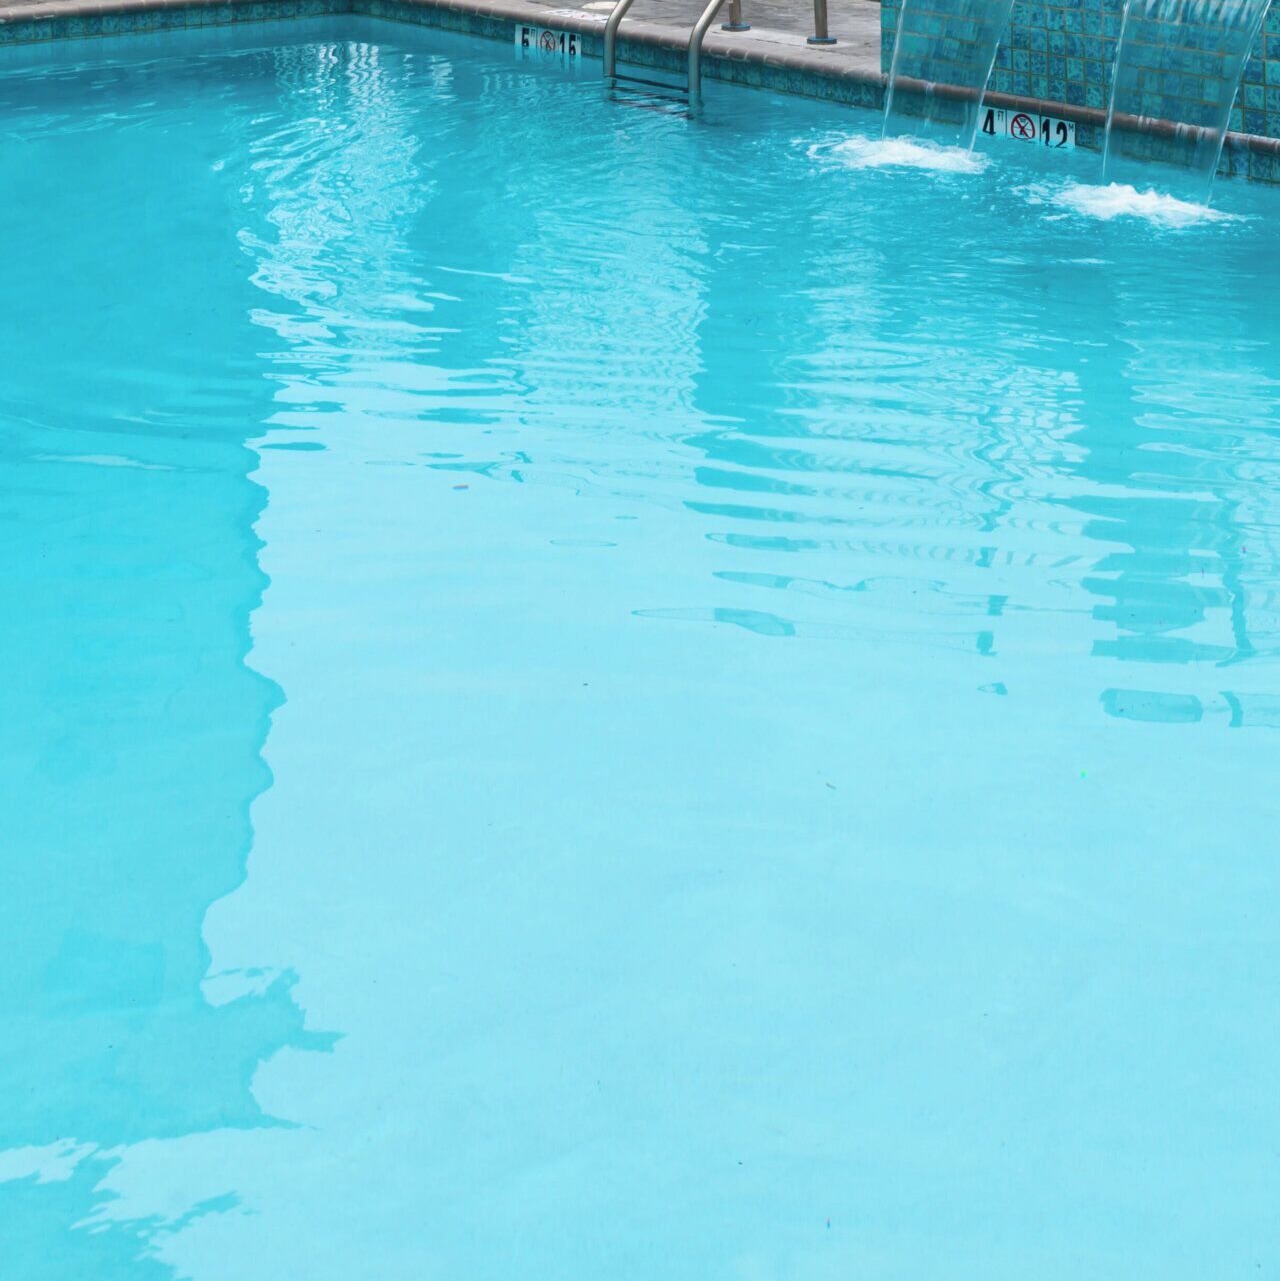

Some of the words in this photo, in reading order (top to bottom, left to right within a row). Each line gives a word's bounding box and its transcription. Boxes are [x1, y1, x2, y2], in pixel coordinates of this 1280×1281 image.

[522, 27, 529, 47] 5
[982, 109, 996, 135] 4
[998, 110, 1005, 121] FT
